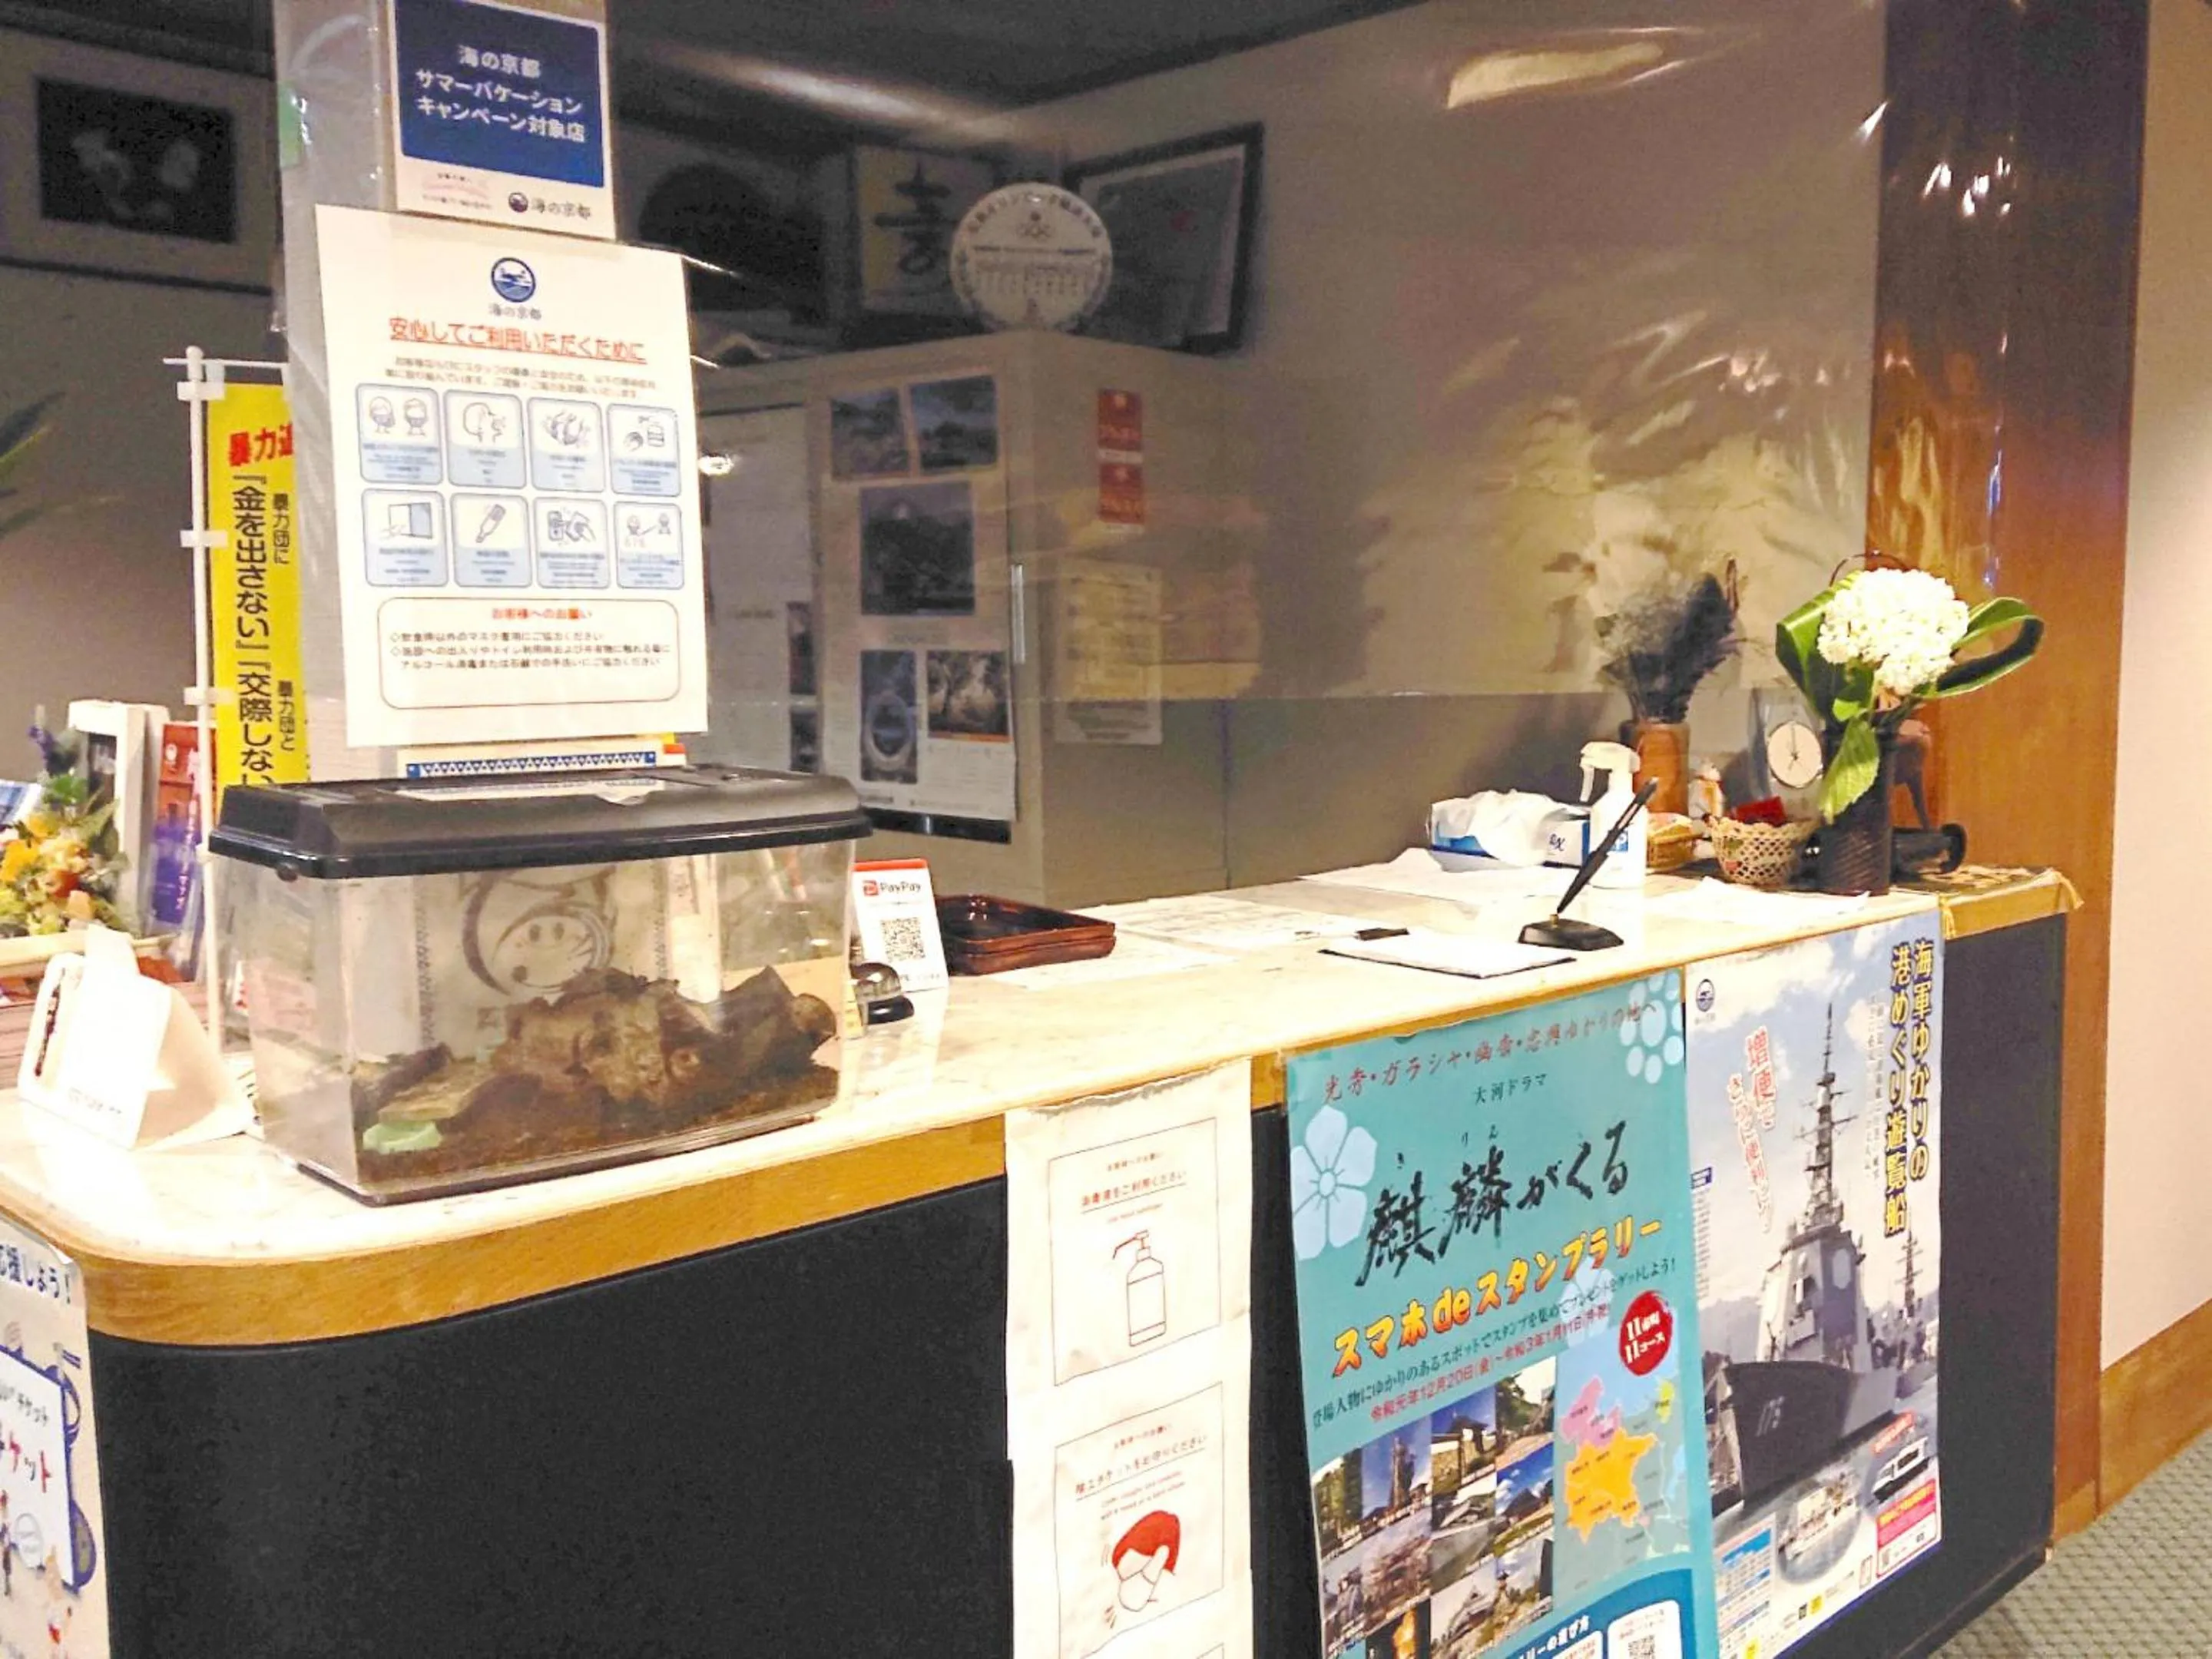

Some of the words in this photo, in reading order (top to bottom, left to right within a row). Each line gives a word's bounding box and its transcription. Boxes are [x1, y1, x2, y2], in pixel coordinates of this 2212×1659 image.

[416, 68, 582, 114] サマーバケーション
[459, 45, 541, 78] 海の京都
[417, 95, 585, 144] キャンペーン対象店
[389, 316, 647, 362] 安心してご利用いただくために
[272, 492, 290, 565] 暴力団に
[277, 680, 296, 751] 暴力団と
[879, 881, 922, 892] PayPay
[1474, 1073, 1548, 1105] 大河ドラマ
[1884, 942, 1913, 1238] 港めぐり遊覧船
[1909, 938, 1935, 1182] 海軍ゆかりの
[1354, 1119, 1629, 1287] 麒麟がくる
[1332, 1215, 1664, 1378] スマホdeスタンプラリー
